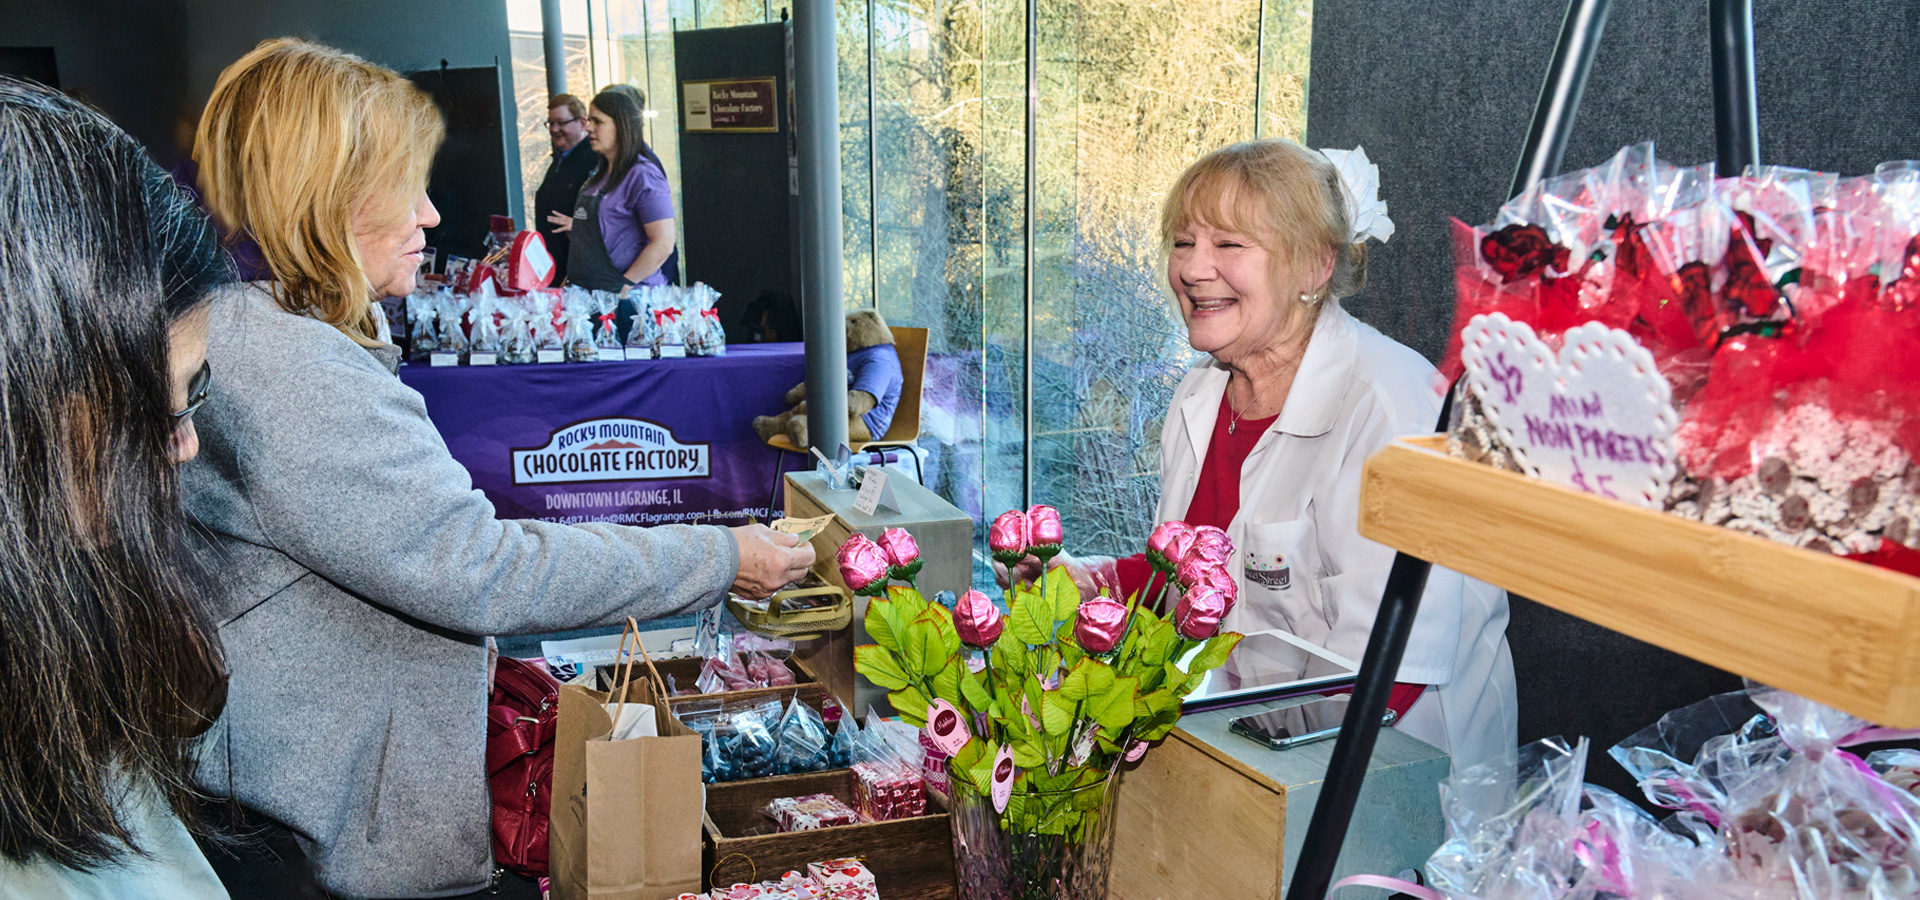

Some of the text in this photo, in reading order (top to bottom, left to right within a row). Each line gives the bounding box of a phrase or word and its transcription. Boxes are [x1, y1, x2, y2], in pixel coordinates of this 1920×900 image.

[712, 88, 758, 100] Rocky Mountain
[712, 103, 740, 113] Chocolate
[741, 103, 763, 115] Factory
[558, 423, 666, 450] ROCKY MOUNTAIN
[523, 448, 699, 479] CHOCOLATE FACTORY
[546, 489, 683, 510] DOWNTOWN LAGRANGE, IL
